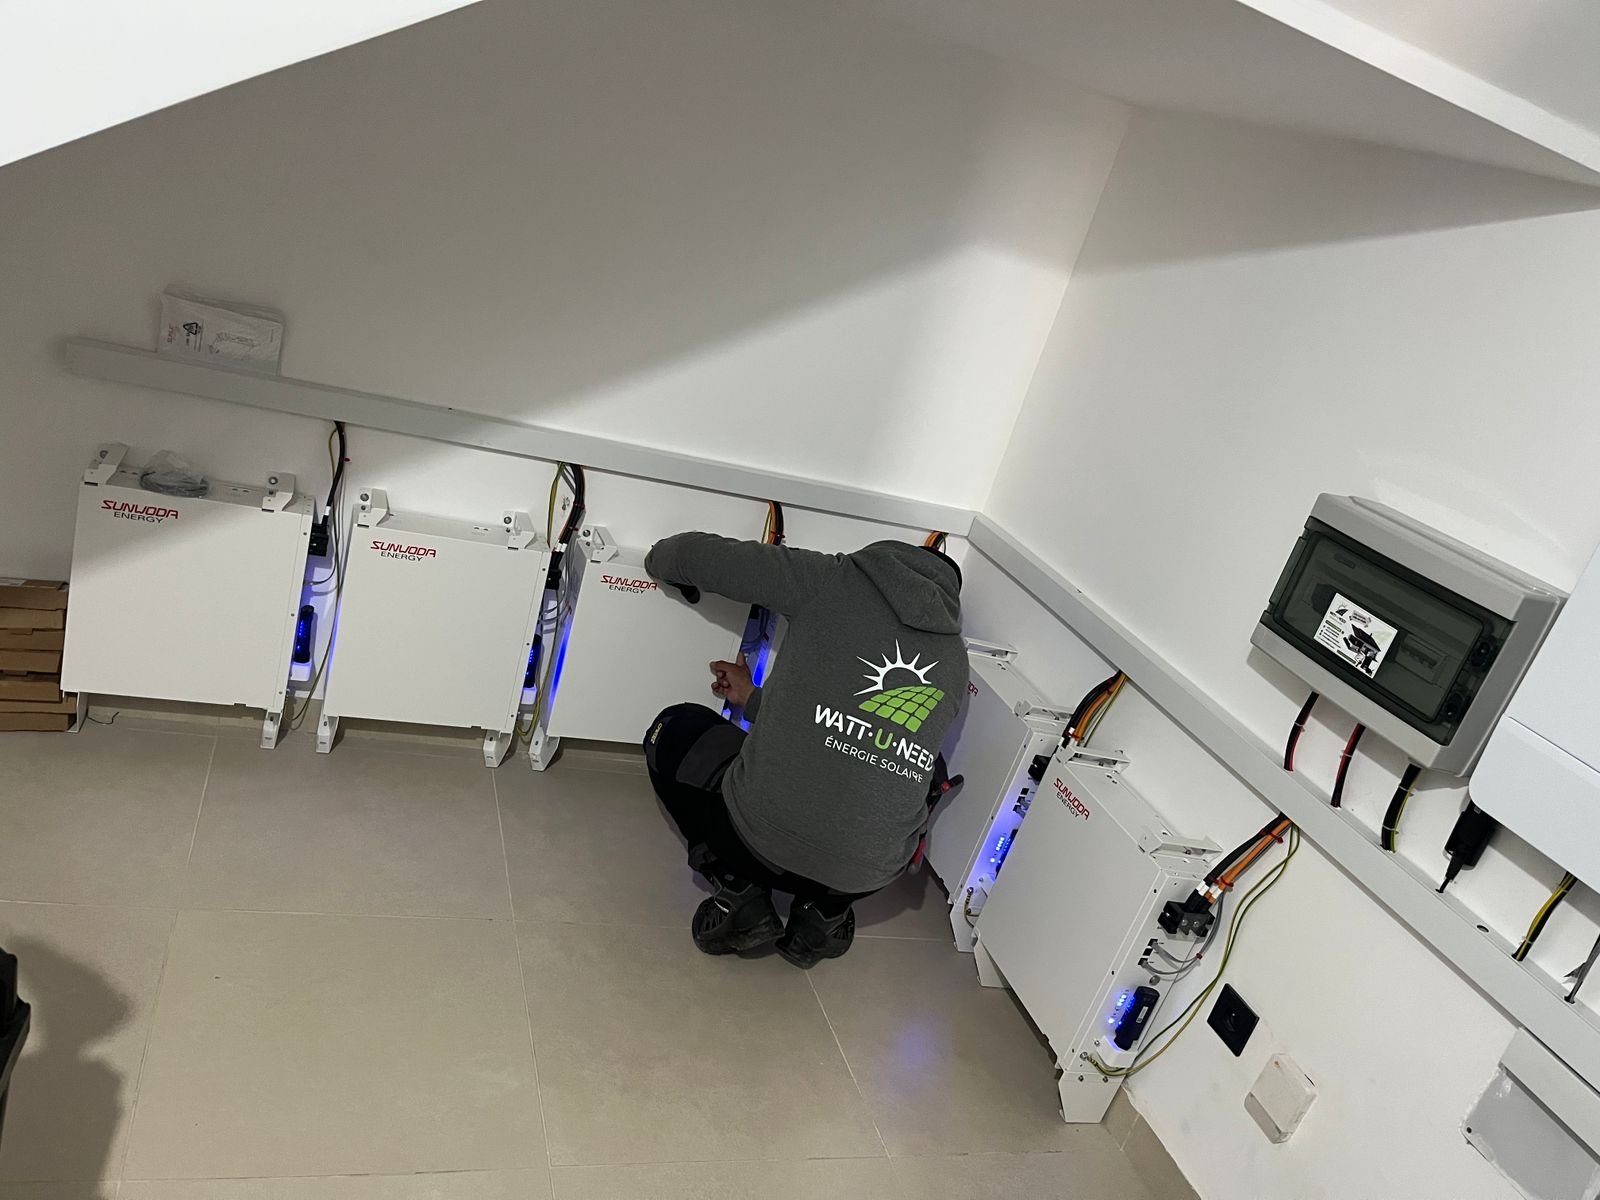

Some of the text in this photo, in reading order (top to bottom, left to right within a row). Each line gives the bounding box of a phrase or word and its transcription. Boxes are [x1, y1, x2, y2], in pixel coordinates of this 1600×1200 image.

[101, 500, 179, 519] SUNWODA
[113, 511, 163, 524] ENERGY
[370, 541, 437, 558] SUNWODA
[380, 551, 423, 562] ENERGY
[608, 584, 645, 594] ENERGY
[824, 735, 923, 783] ÉNERGIE SOLAIRE
[1056, 791, 1080, 818] ENERGY
